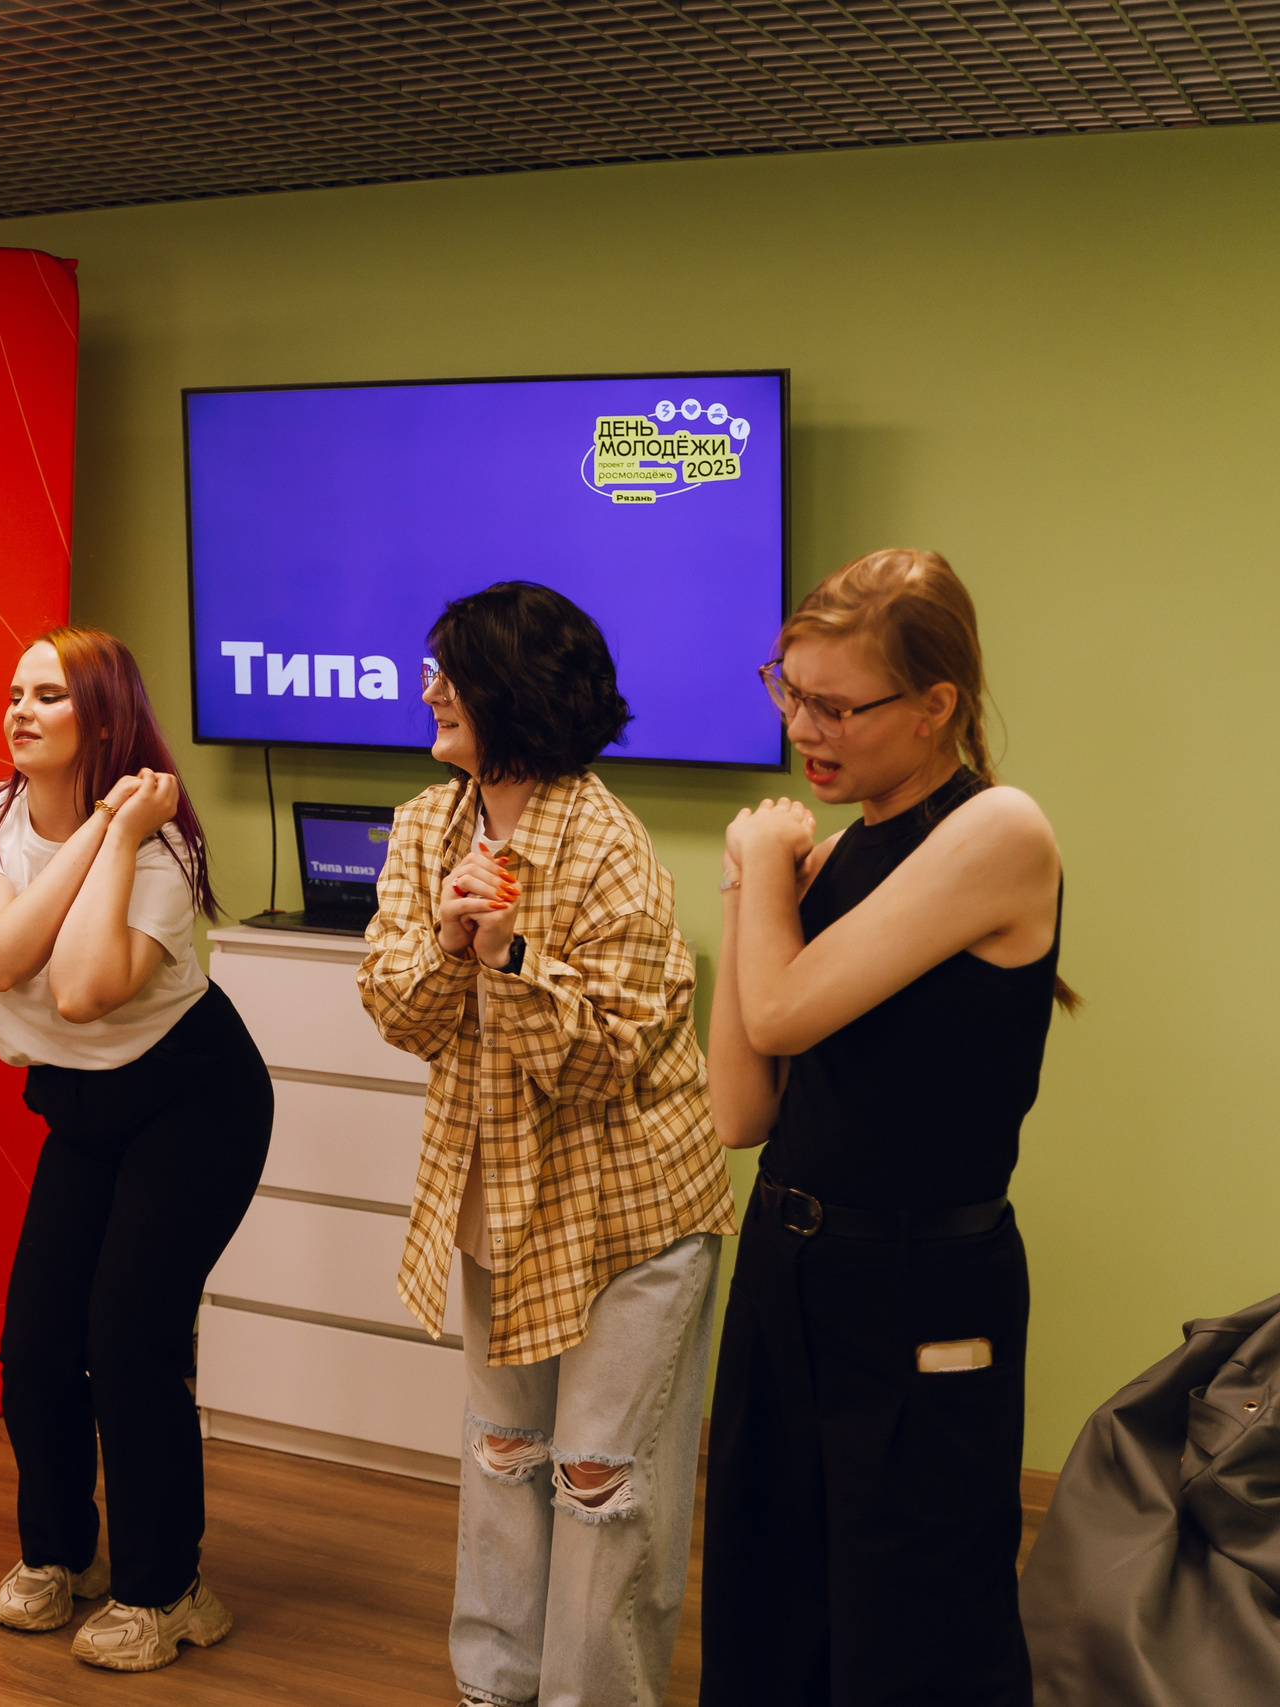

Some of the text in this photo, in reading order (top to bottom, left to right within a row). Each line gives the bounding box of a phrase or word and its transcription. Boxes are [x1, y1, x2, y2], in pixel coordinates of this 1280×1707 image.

[598, 420, 654, 440] ДЕНЬ
[598, 435, 726, 459] МОЛОДЁЖИ
[598, 461, 624, 469] проект
[686, 458, 736, 479] 2025
[598, 470, 673, 482] росмолодёжь
[616, 494, 653, 502] Рязань
[221, 640, 399, 701] Типа
[310, 860, 376, 876] Типа квиз
